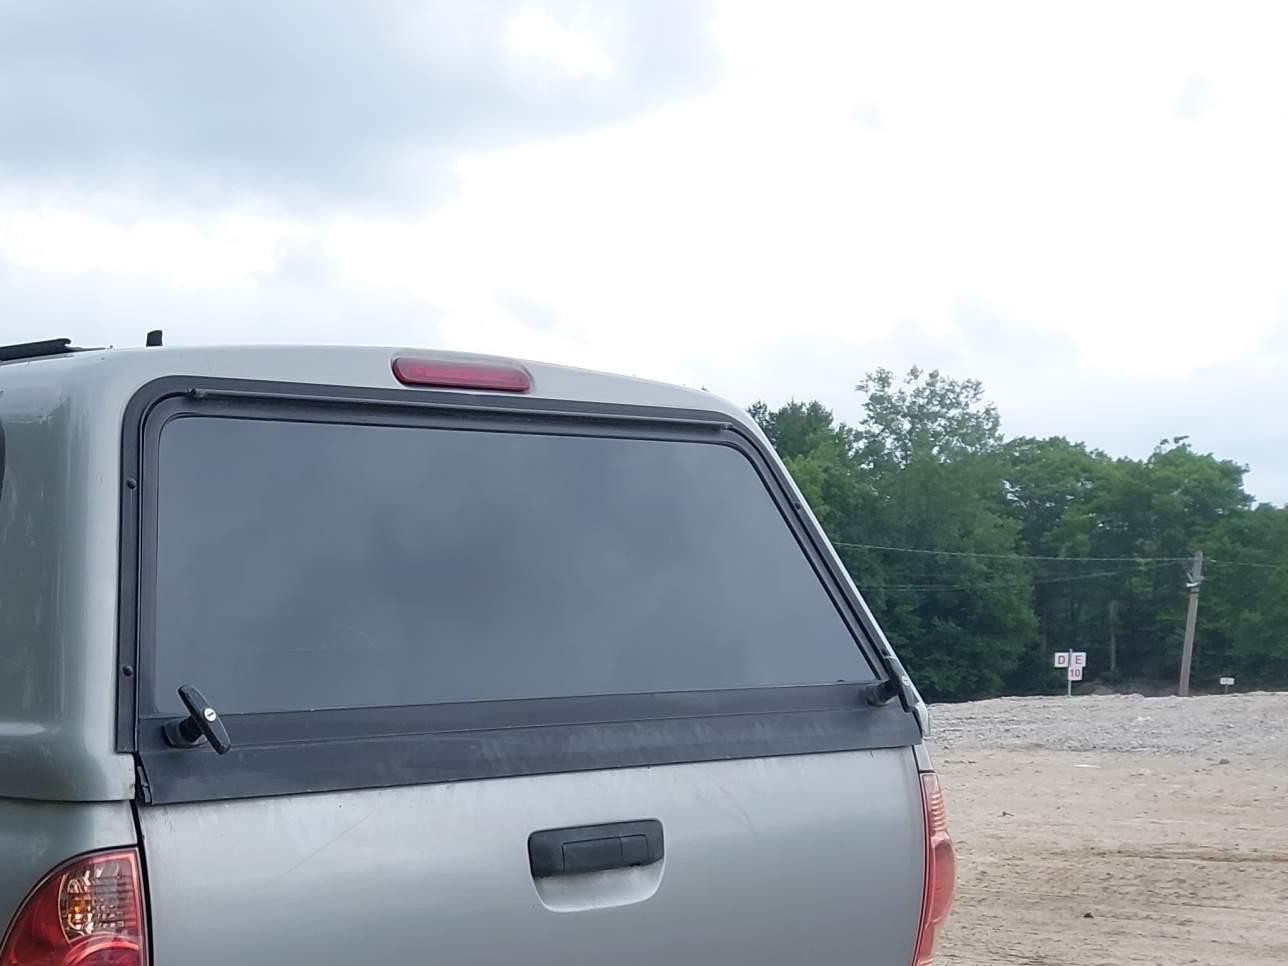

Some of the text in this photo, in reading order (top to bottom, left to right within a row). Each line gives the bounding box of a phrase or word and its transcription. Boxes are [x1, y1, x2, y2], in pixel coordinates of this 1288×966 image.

[1058, 655, 1066, 665] D
[1075, 655, 1082, 665] E
[1070, 668, 1081, 677] 10
